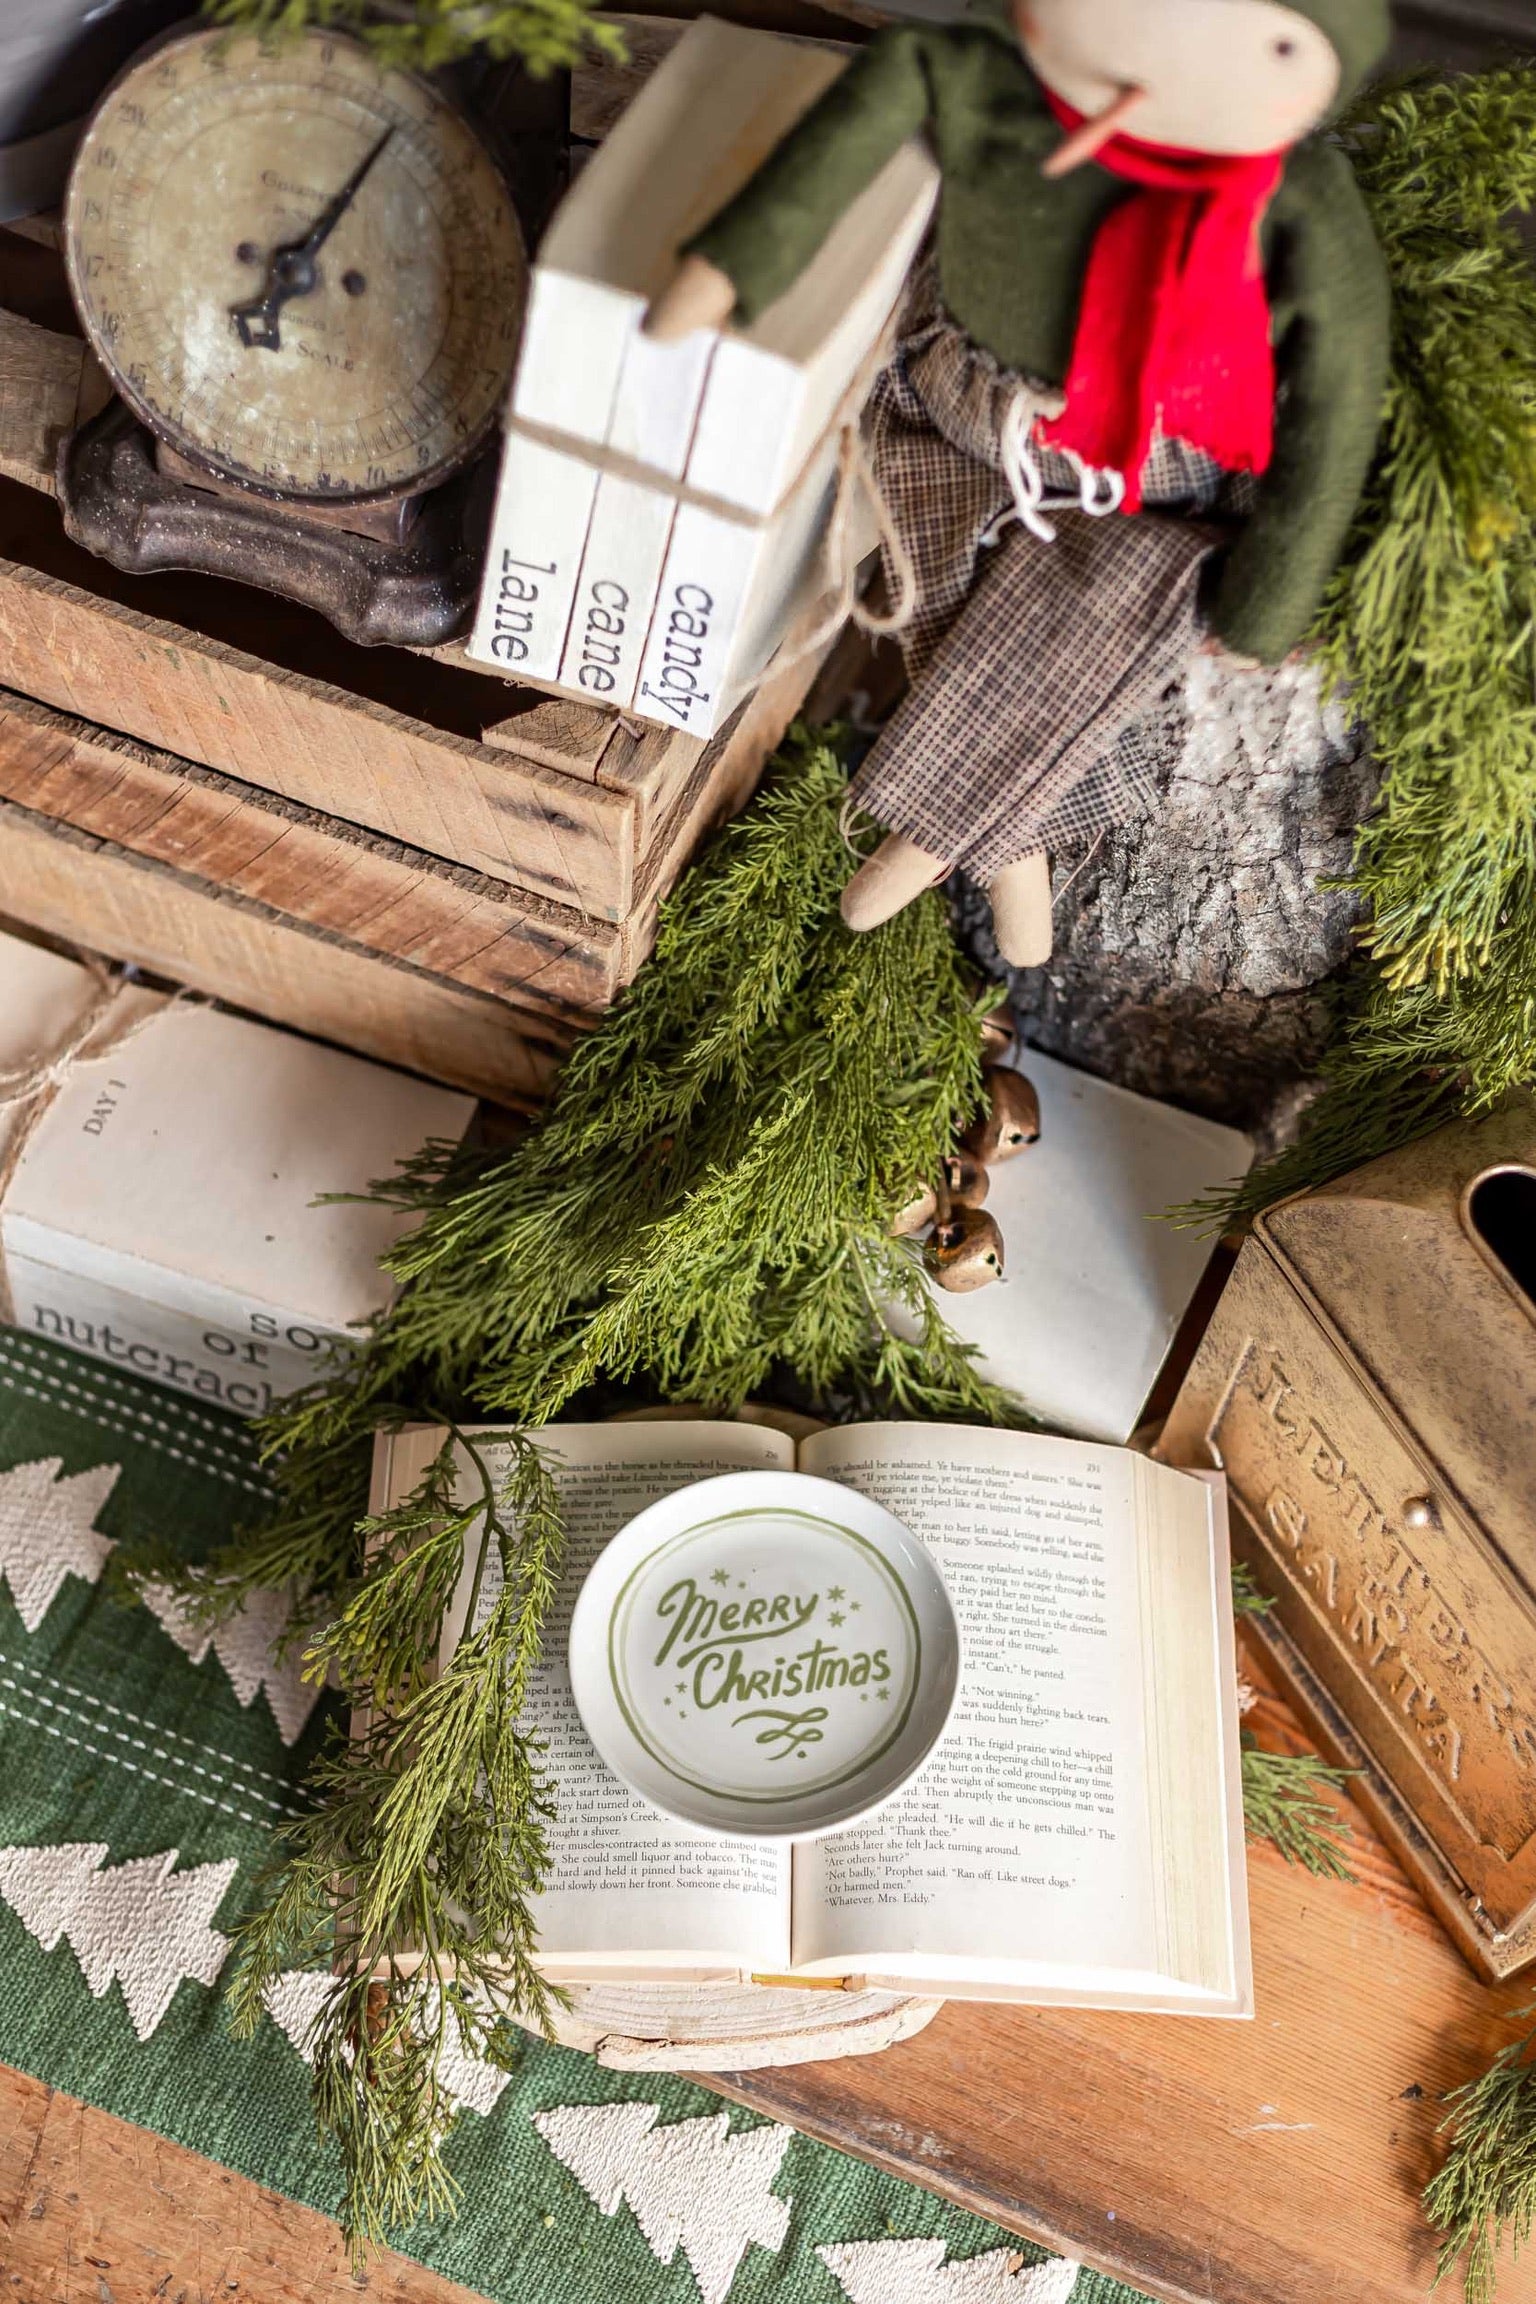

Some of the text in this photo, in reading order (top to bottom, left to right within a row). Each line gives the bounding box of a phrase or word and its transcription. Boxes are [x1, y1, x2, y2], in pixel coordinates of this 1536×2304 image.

[491, 549, 557, 661] lane
[578, 580, 630, 692] cane
[641, 583, 714, 721] candy
[82, 1090, 118, 1136] DAY
[203, 1331, 271, 1370] of
[943, 1559, 984, 1571] Someone
[987, 1562, 1024, 1576] splashed
[1055, 1569, 1089, 1586] through
[1091, 1575, 1105, 1588] the
[958, 1585, 977, 1597] they
[980, 1586, 1000, 1598] paid
[1002, 1588, 1017, 1599] her
[966, 1609, 1107, 1637] right. She turned the direction
[1266, 1485, 1462, 1783] SANTA
[969, 1635, 1061, 1656] noise the struggle.
[1020, 1665, 1066, 1680] he panted.
[552, 1710, 568, 1720] she
[974, 1711, 1018, 1725] thou hurt
[982, 1700, 1111, 1724] suddenly fighting back tears.
[550, 1750, 582, 1759] certain
[584, 1748, 595, 1758] of
[966, 1736, 1113, 1763] The frigid prairie wind whipped
[545, 1762, 566, 1771] than
[982, 1752, 1113, 1775] deepening chill chill
[564, 1775, 592, 1784] want?
[949, 1761, 1113, 1789] hurt on the cold ground for any time.
[557, 1786, 629, 1798] Jack start down
[933, 1774, 1114, 1801] the weight of someone stepping onto
[576, 1798, 629, 1810] had turned
[903, 1800, 942, 1810] the seat.
[924, 1786, 1114, 1815] Then abruptly the unconscious man was
[581, 1811, 662, 1825] Simpson's Creek,
[878, 1813, 894, 1822] she
[898, 1812, 937, 1824] pleaded.
[944, 1814, 964, 1825] "He
[968, 1816, 985, 1826] will
[990, 1817, 1004, 1828] die
[1019, 1819, 1031, 1830] he
[1034, 1823, 1052, 1833] gets
[1097, 1829, 1116, 1841] The
[549, 1826, 620, 1839] fought shiver.
[846, 1826, 886, 1839] stopped.
[890, 1825, 926, 1836] "Thank
[568, 1838, 757, 1851] muscles contracted someone climbed
[824, 1839, 1022, 1856] Seconds later she felt Jack turning around.
[561, 1851, 758, 1865] She could smell liquor and tobacco. The
[847, 1854, 875, 1864] others
[557, 1864, 740, 1877] hard and held pinned back against
[885, 1865, 923, 1878] Prophet
[926, 1867, 948, 1877] said.
[951, 1868, 975, 1879] "Ran
[997, 1871, 1018, 1882] Like
[1021, 1875, 1045, 1885] street
[568, 1878, 777, 1895] slowly down her front. Someone else grabbed
[844, 1880, 880, 1892] harmed
